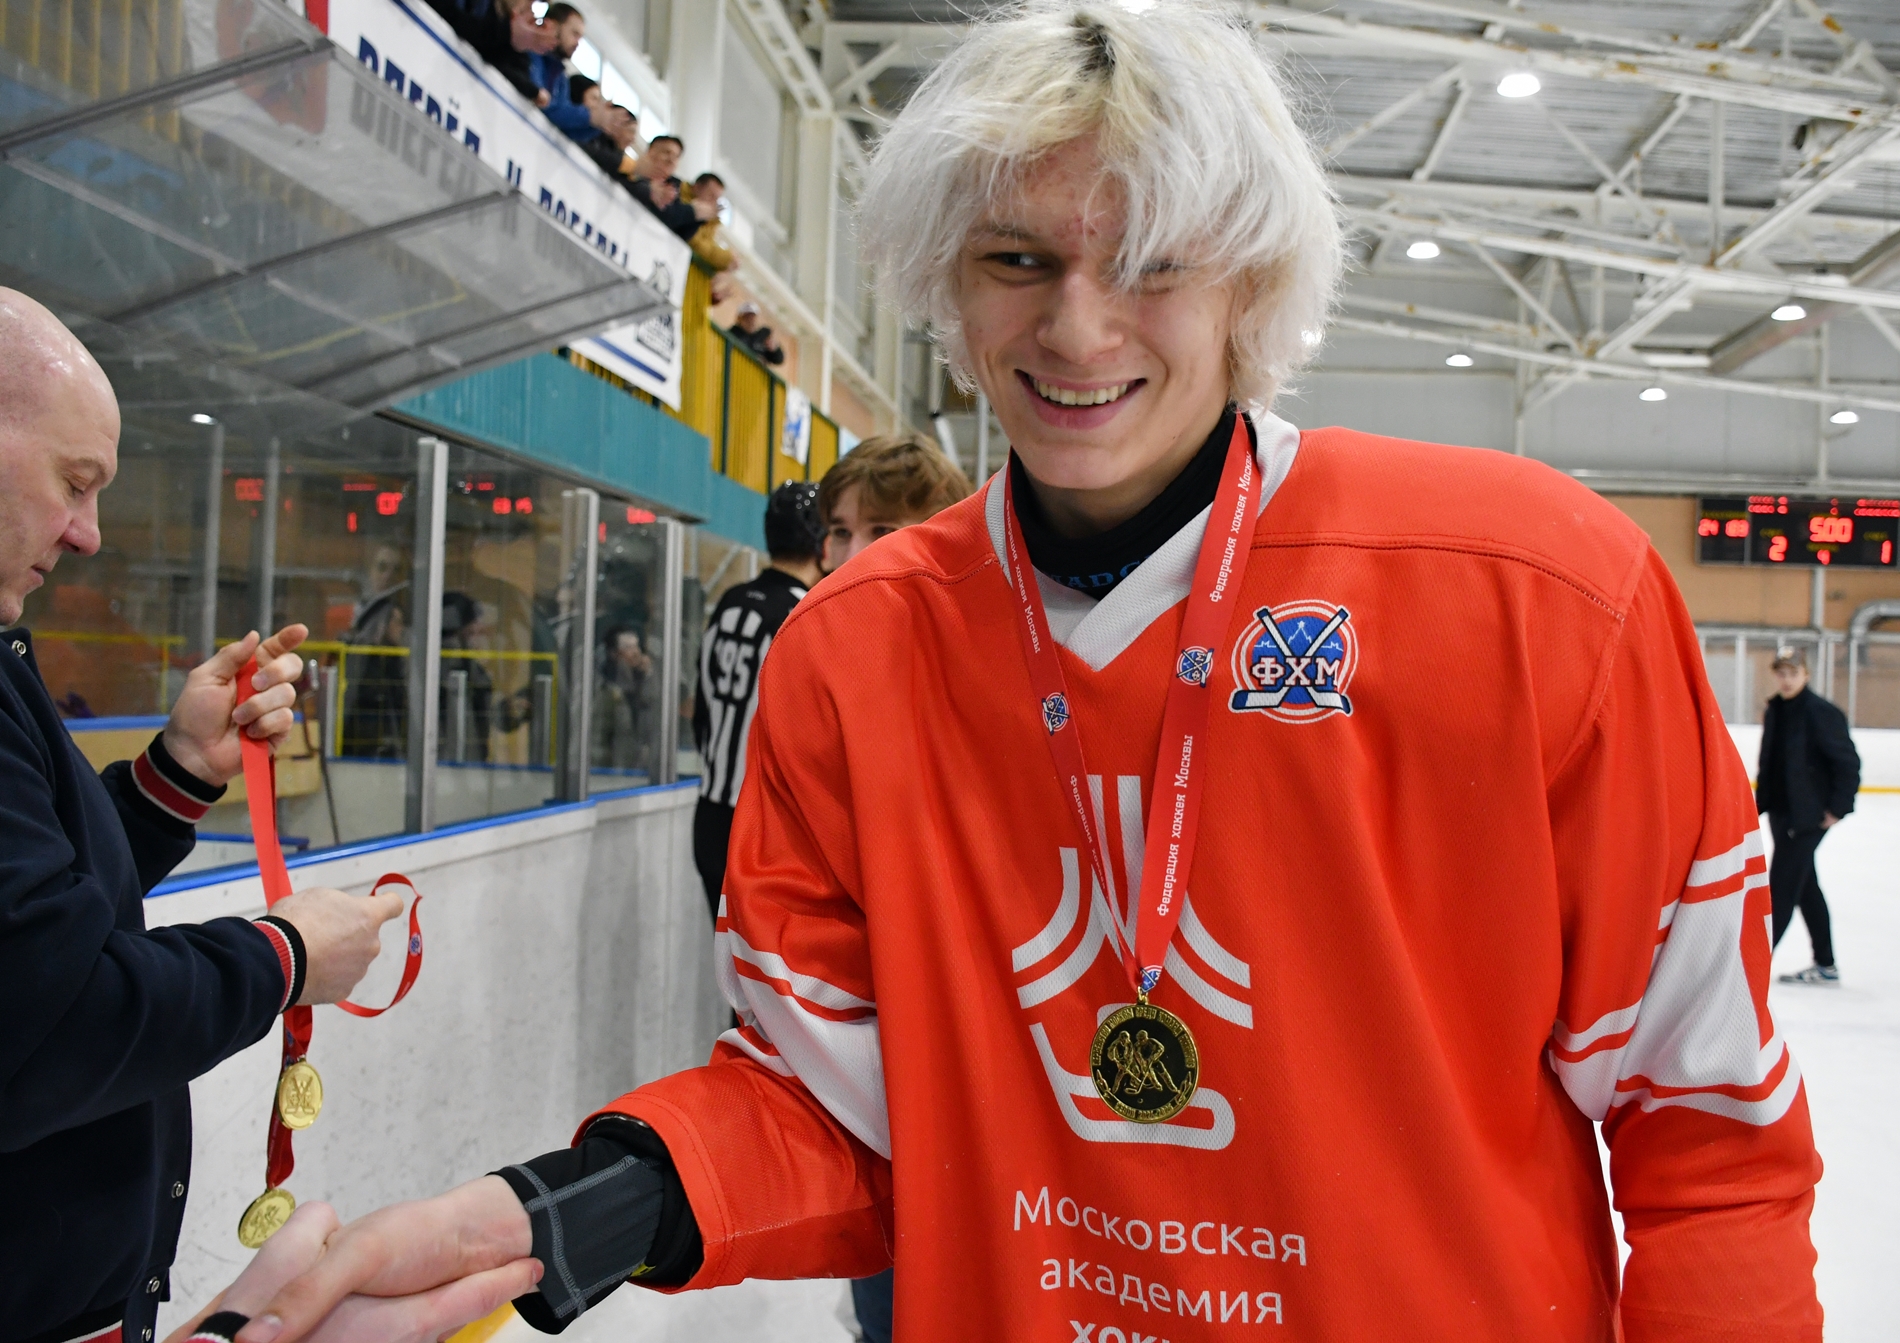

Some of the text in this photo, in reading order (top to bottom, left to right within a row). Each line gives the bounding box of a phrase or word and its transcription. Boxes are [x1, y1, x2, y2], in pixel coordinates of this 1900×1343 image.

[1209, 537, 1237, 602] Федерация
[1230, 494, 1247, 534] хоккея
[1769, 535, 1788, 562] 2
[1881, 540, 1892, 564] 1
[1024, 604, 1041, 653] Москвы
[714, 638, 755, 700] 95
[1251, 656, 1341, 687] ФХМ
[1070, 774, 1093, 844] Федерация
[1157, 735, 1193, 916] Федерация хоккея Москвы
[1013, 1186, 1307, 1266] Московская
[1040, 1258, 1283, 1324] академия
